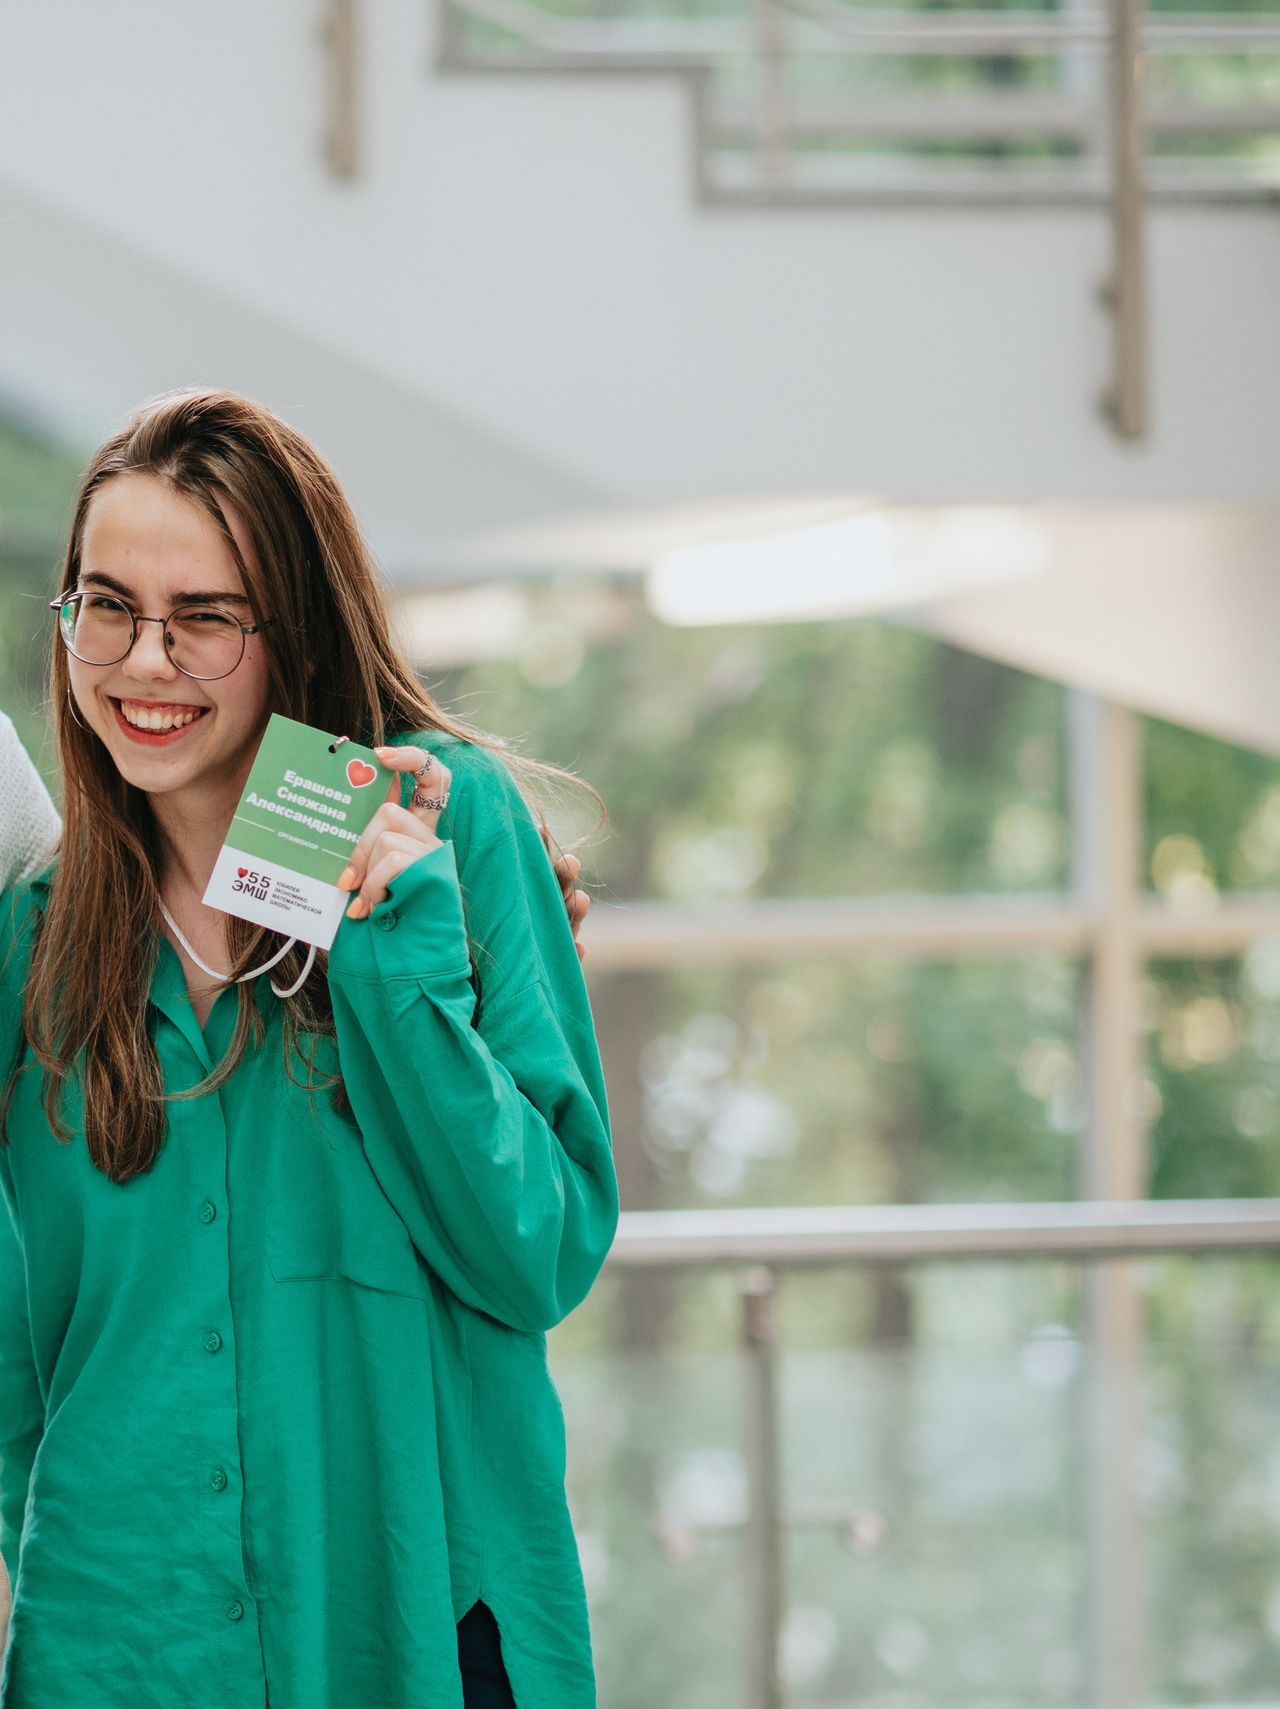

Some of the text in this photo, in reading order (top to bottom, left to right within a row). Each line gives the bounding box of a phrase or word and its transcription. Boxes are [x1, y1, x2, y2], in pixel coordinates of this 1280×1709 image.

[283, 769, 352, 805] Ерашова
[276, 785, 347, 821] Снежана
[277, 831, 319, 850] ОРГАНИЗАТОР
[247, 871, 272, 889] 55
[276, 881, 300, 893] ЮБИЛЕЙ
[231, 879, 268, 901] ЭМШ
[274, 887, 308, 903] ЭКОНОМИКО
[269, 899, 291, 911] ШКОЛЫ
[272, 893, 322, 915] МАТЕМАТИЧЕСКОЙ
